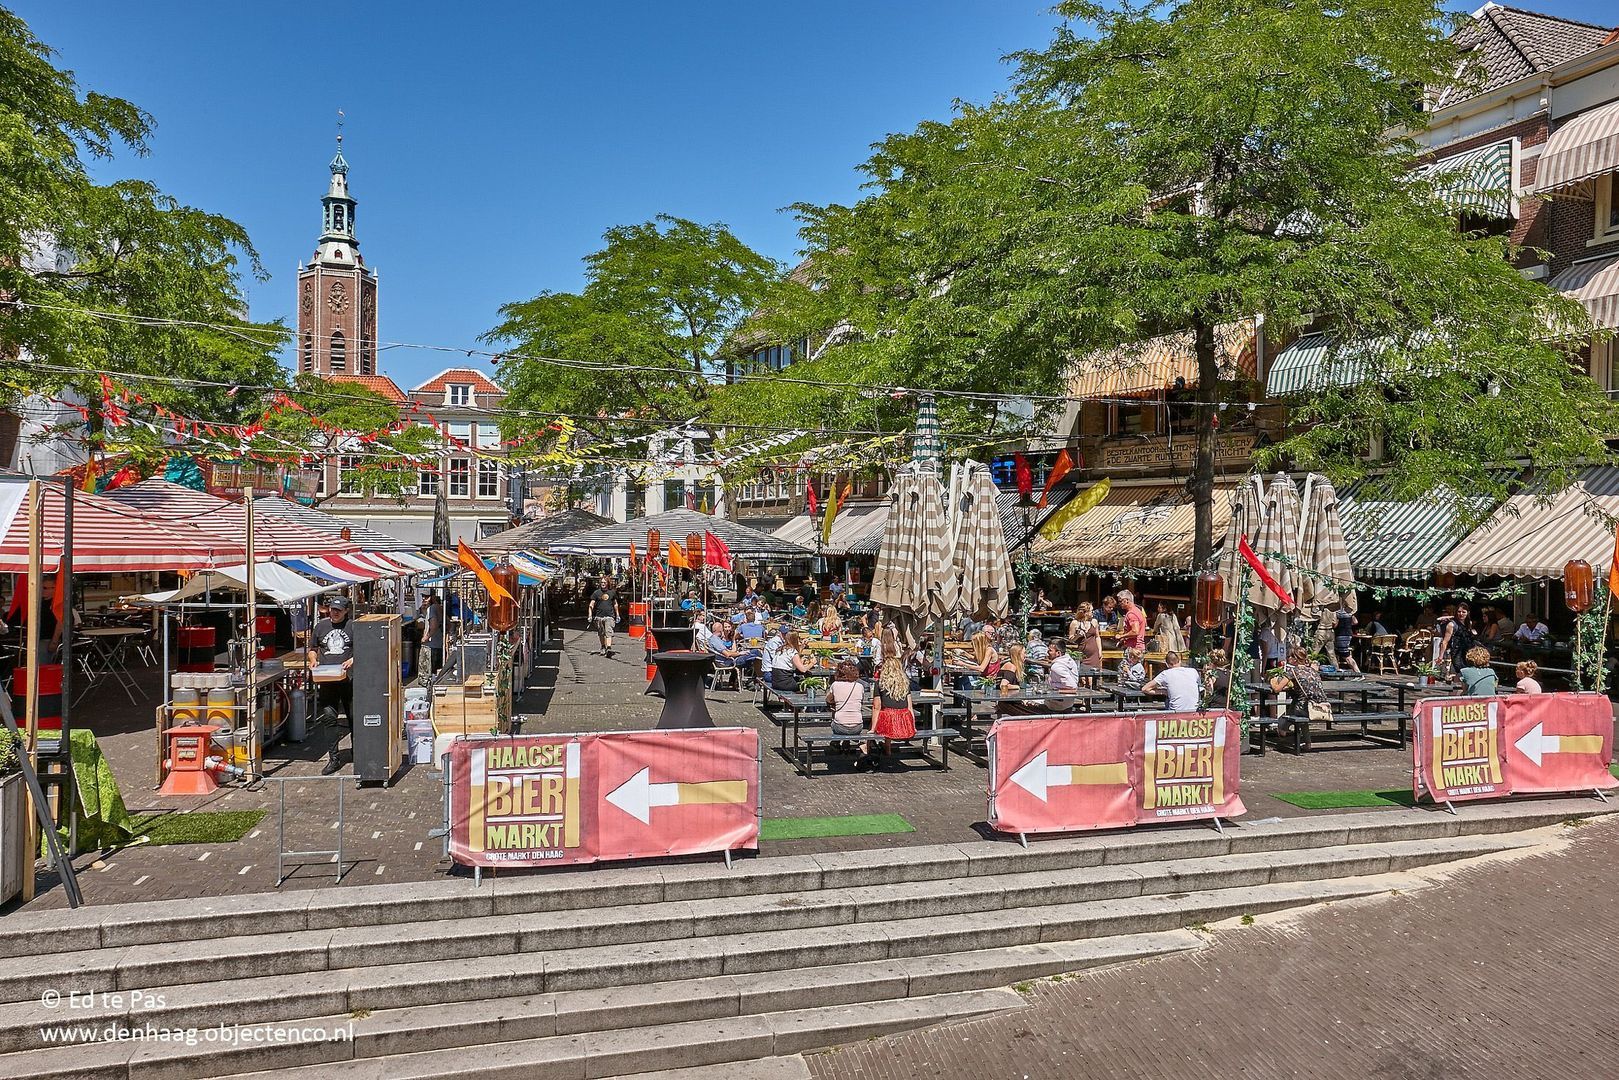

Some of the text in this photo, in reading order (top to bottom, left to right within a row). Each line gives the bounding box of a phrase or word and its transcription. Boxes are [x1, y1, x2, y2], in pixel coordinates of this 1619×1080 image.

[1442, 703, 1487, 723] HAAGSE
[1158, 718, 1214, 739] HAAGSE
[1442, 726, 1488, 761] BIER
[488, 744, 564, 769] HAAGSE
[1156, 743, 1213, 779] BIER
[1443, 764, 1490, 788] MARKT
[487, 773, 564, 816] BIER
[1156, 784, 1213, 807] MARKT
[487, 823, 564, 850] MARKT
[485, 849, 564, 861] GROTE MARKT DEN HAAG
